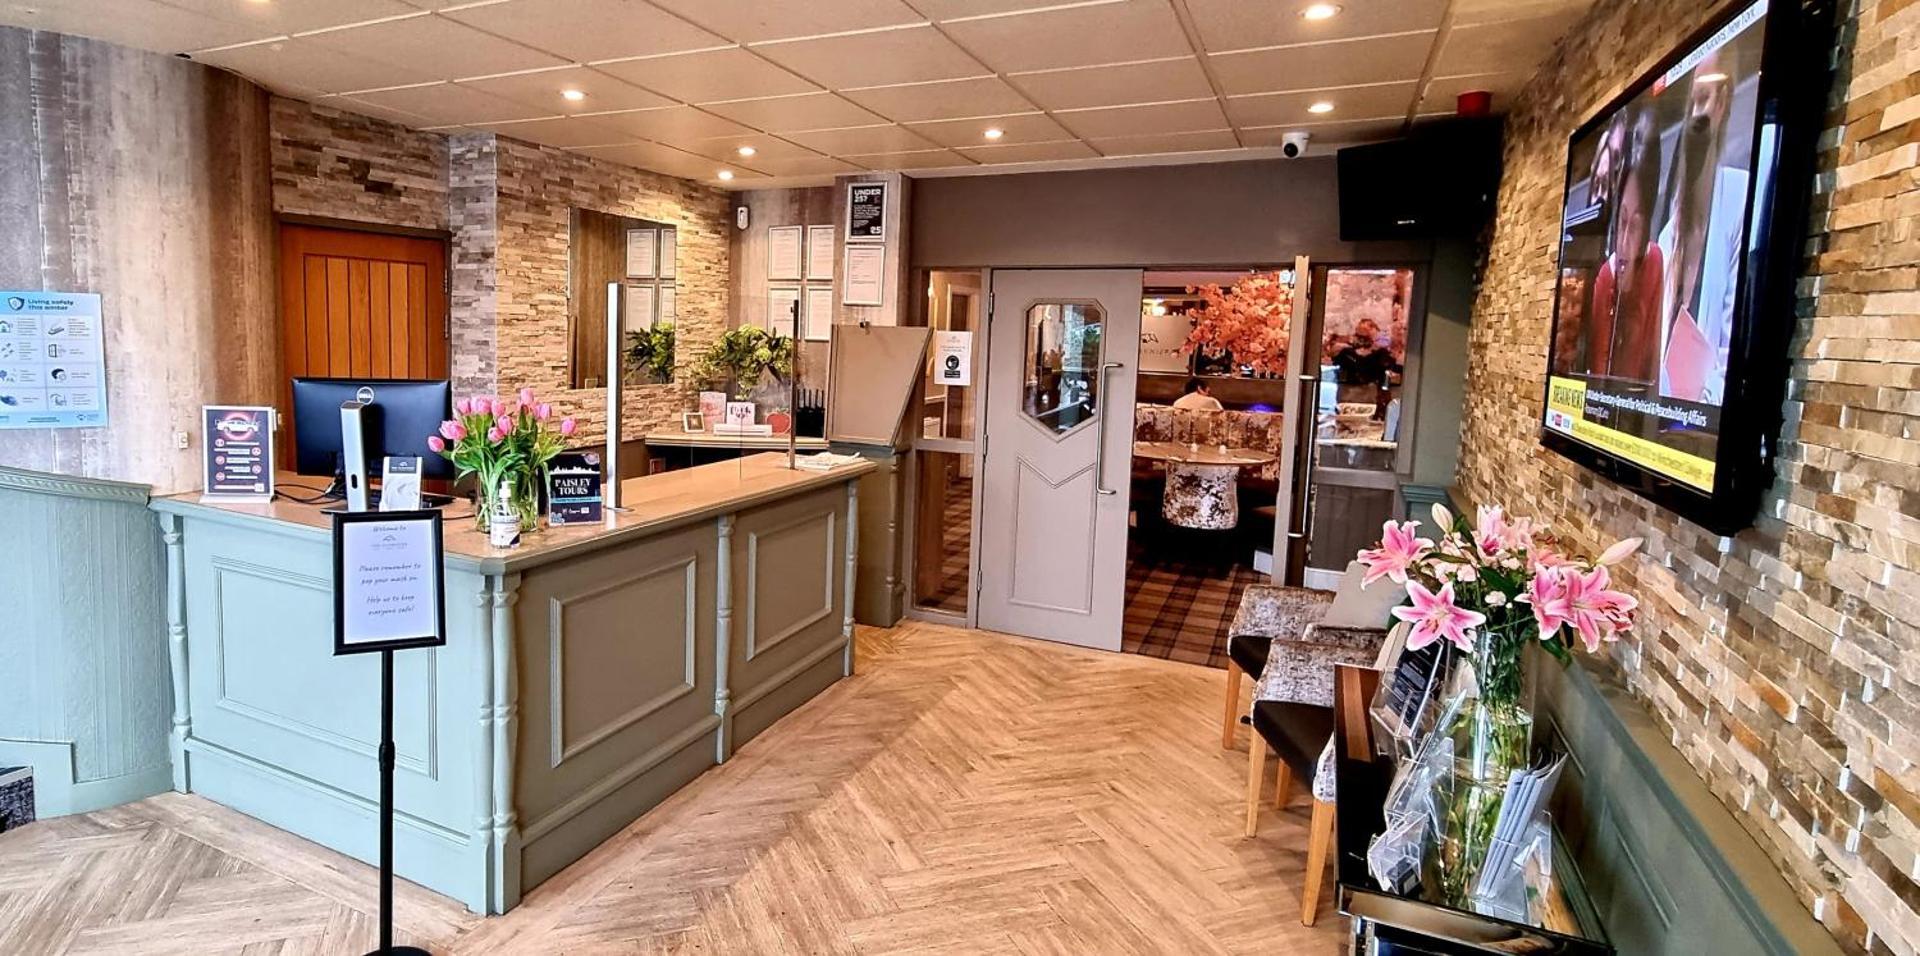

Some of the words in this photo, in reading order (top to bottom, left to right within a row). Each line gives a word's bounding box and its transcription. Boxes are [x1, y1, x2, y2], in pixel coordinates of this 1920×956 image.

[854, 195, 868, 203] 25?
[1688, 409, 1707, 427] Affairs
[555, 478, 591, 487] PAISLEY
[558, 487, 588, 495] TOURS
[359, 564, 380, 573] Please
[381, 562, 412, 570] remember
[375, 578, 389, 586] your
[367, 595, 382, 604] Help
[368, 607, 396, 616] everyone
